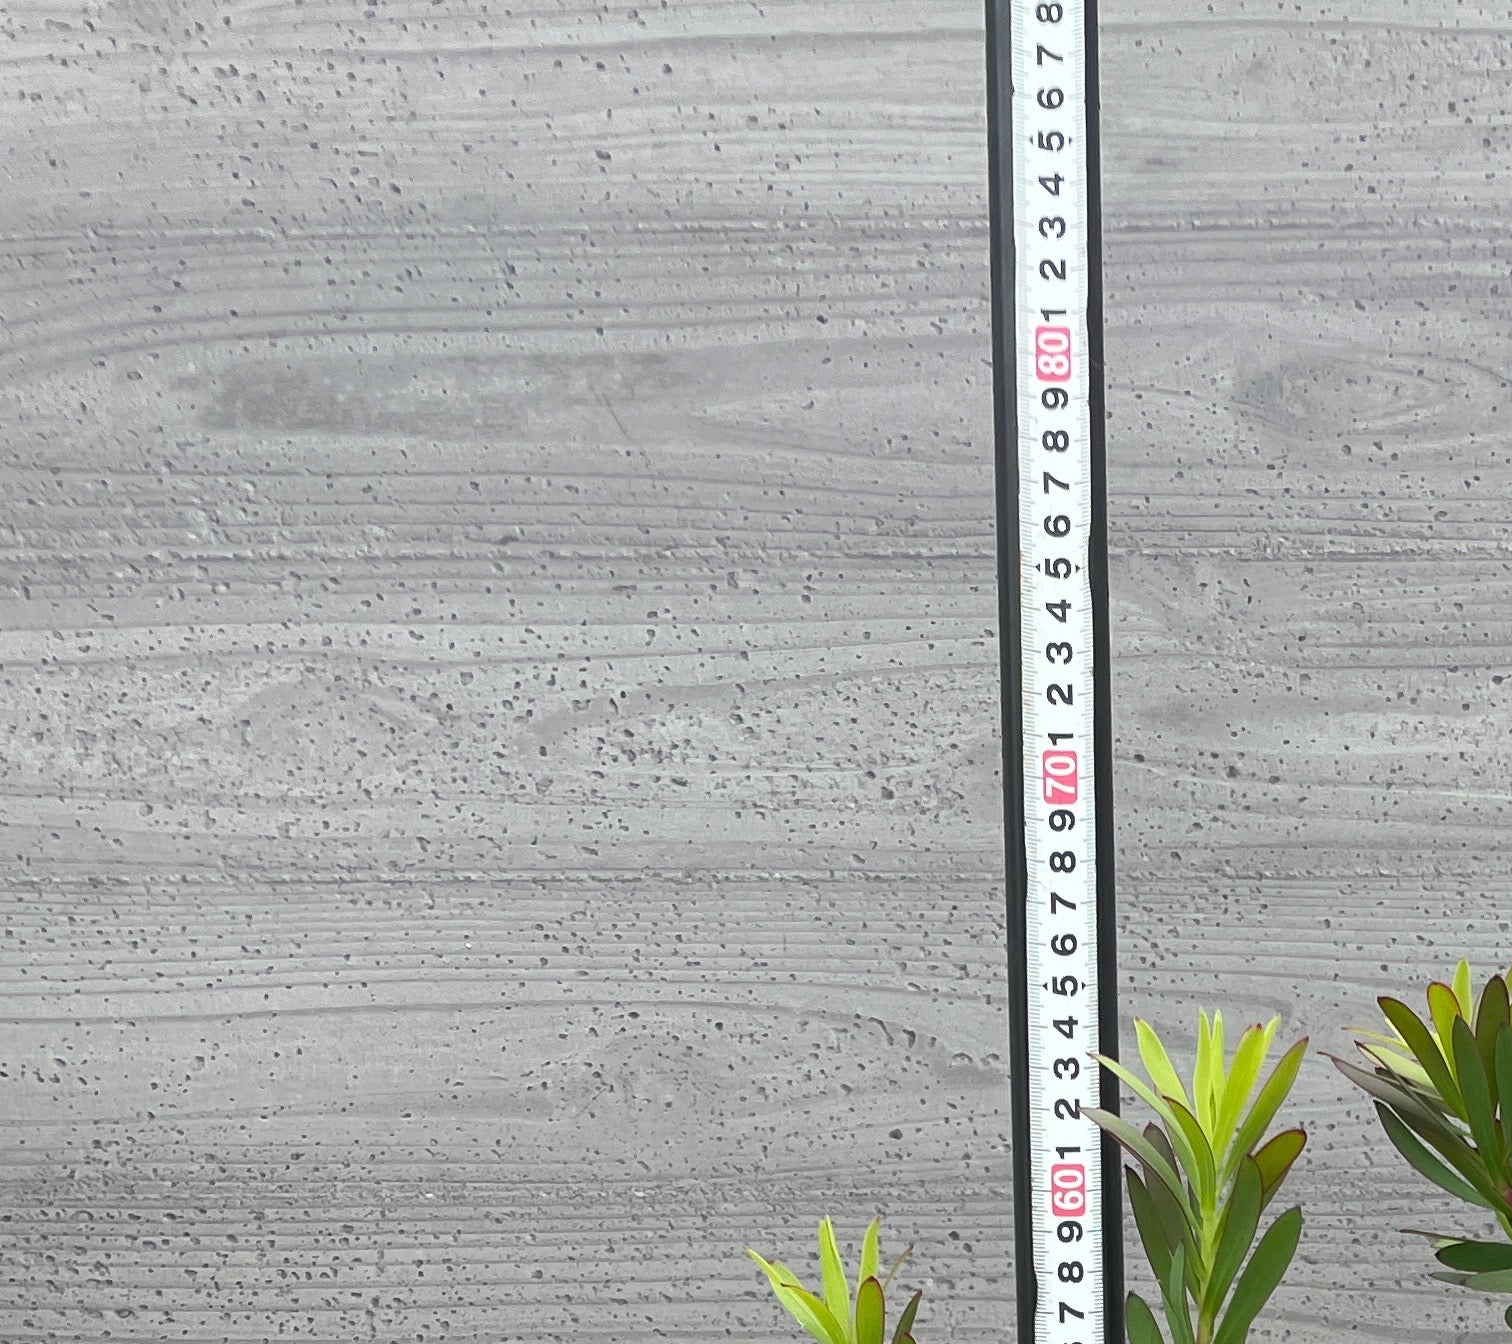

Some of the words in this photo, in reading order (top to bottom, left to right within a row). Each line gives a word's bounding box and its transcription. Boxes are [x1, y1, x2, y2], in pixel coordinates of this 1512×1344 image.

[1037, 3, 1063, 23] 8
[1037, 45, 1063, 65] 7
[1037, 88, 1064, 109] 6
[1038, 131, 1065, 152] 5
[1038, 174, 1065, 195] 4
[1039, 216, 1066, 238] 3
[1040, 260, 1066, 280] 2
[1041, 310, 1067, 321] 1
[1038, 331, 1069, 376] 80
[1042, 388, 1068, 408] 9
[1043, 431, 1069, 451] 8
[1044, 472, 1069, 493] 7
[1044, 515, 1070, 537] 6
[1045, 558, 1071, 578] 5
[1046, 600, 1071, 622] 4
[1046, 642, 1072, 664] 3
[1047, 684, 1073, 705] 2
[1048, 733, 1073, 745] 1
[1045, 756, 1075, 797] 70
[1049, 810, 1075, 831] 9
[1050, 851, 1075, 872] 8
[1051, 893, 1076, 914] 7
[1051, 934, 1077, 955] 6
[1053, 976, 1078, 996] 5
[1053, 1016, 1078, 1038] 4
[1054, 1058, 1079, 1079] 3
[1055, 1099, 1080, 1119] 2
[1056, 1147, 1080, 1159] 1
[1054, 1169, 1084, 1210] 60
[1057, 1221, 1082, 1242] 9
[1058, 1261, 1083, 1283] 8
[1059, 1302, 1084, 1323] 7
